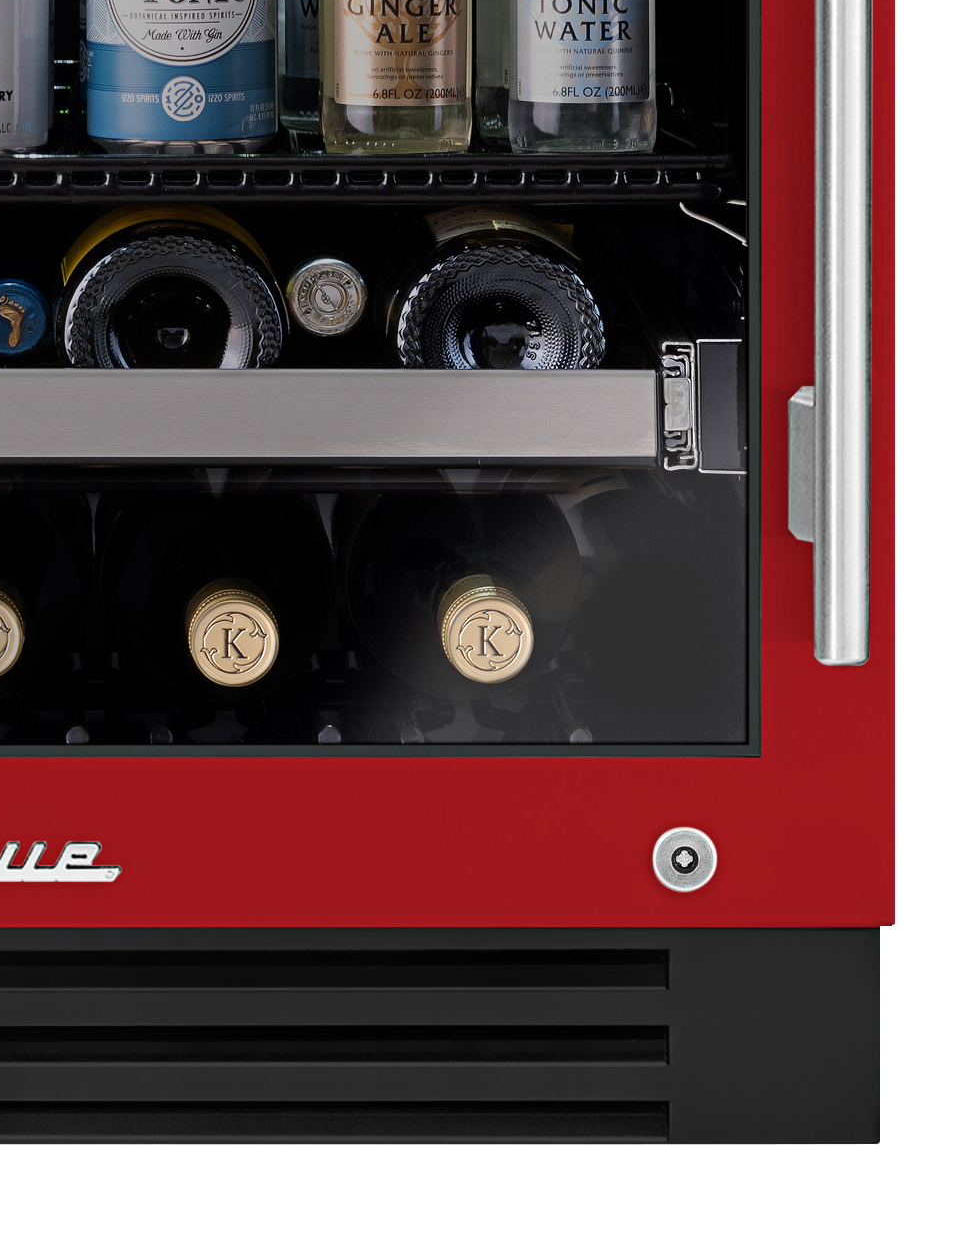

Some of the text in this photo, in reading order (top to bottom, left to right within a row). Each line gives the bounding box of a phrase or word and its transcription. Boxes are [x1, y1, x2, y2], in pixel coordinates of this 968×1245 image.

[130, 12, 167, 20] BOTANICAL
[142, 28, 223, 43] Made With Gin
[376, 23, 432, 43] ALE
[535, 21, 632, 41] WATER
[121, 94, 159, 104] 1220 SPIRITS
[208, 93, 245, 102] 1220 SPIRITS
[373, 88, 459, 101] 6.8FL OZ (200ML)
[553, 85, 640, 99] 6.8FL OZ (200ML)
[222, 627, 249, 659] K
[477, 625, 505, 657] K
